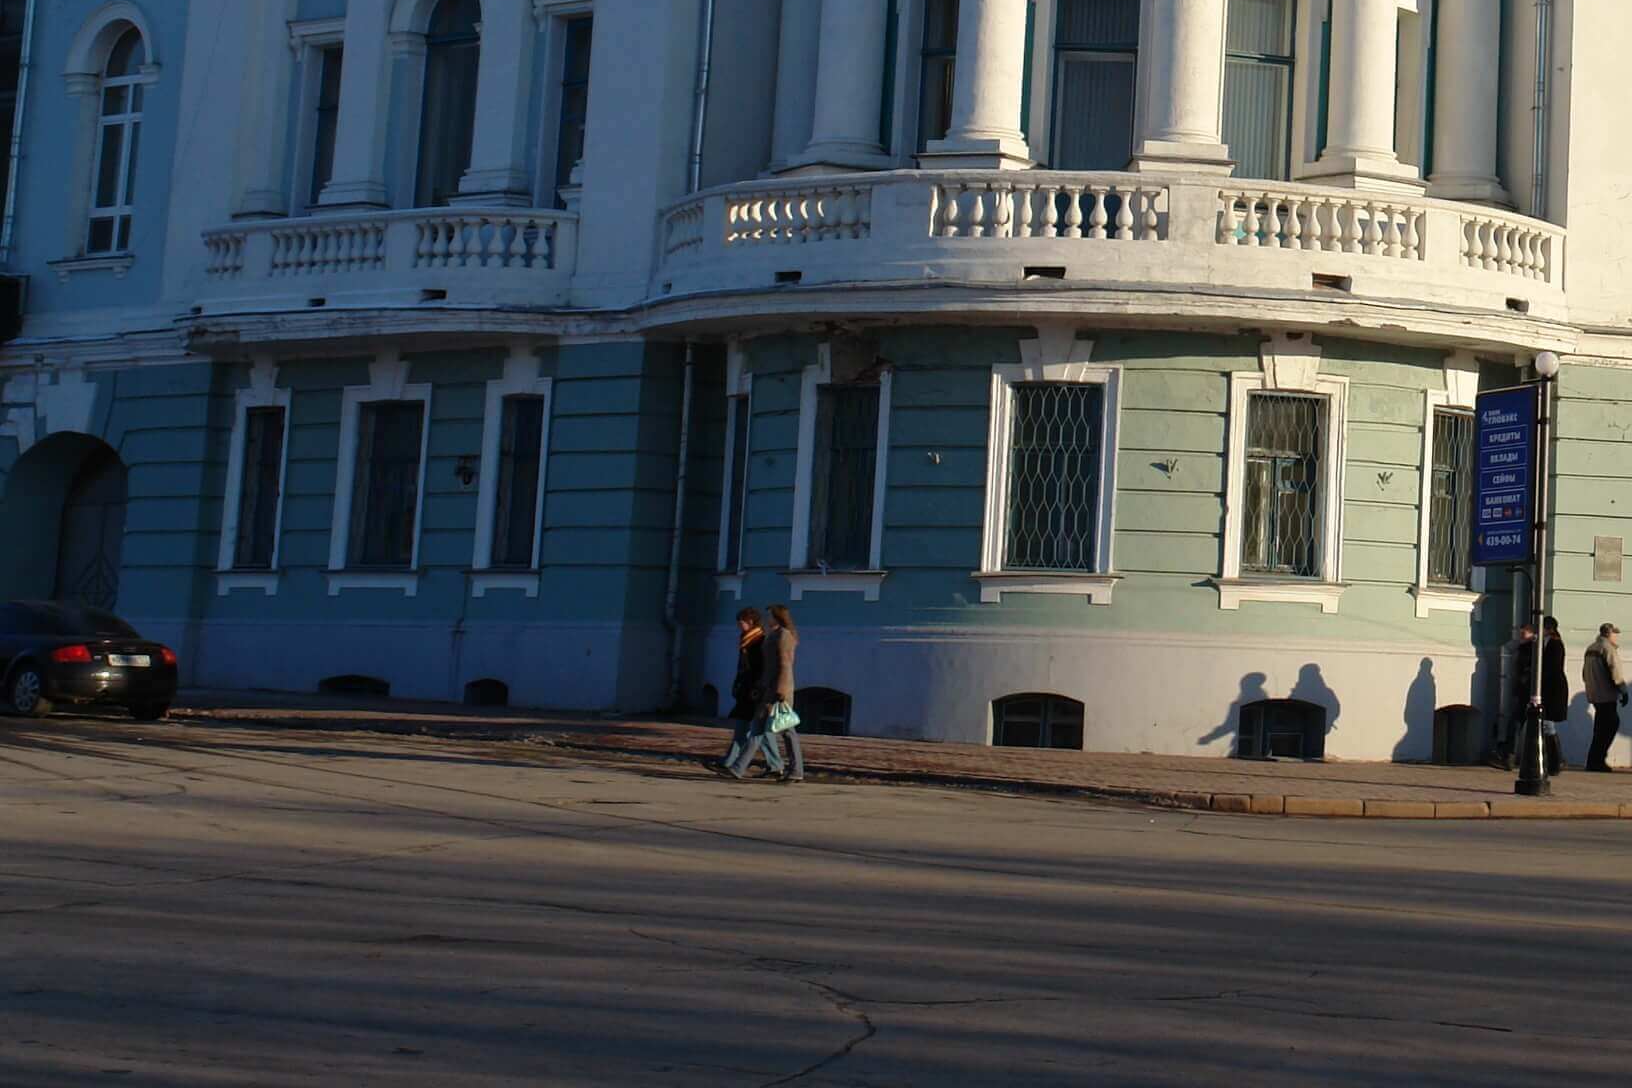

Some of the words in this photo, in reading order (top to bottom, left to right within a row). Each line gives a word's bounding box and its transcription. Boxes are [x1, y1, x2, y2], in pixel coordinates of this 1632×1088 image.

[1489, 432, 1520, 443] КРЕДИТЫ
[1490, 453, 1518, 463] ВКЛАДЫ
[1492, 473, 1515, 484] СЕЙФЫ
[1485, 494, 1520, 505] БАНКОМАТ
[1486, 534, 1520, 546] 439-00-74
